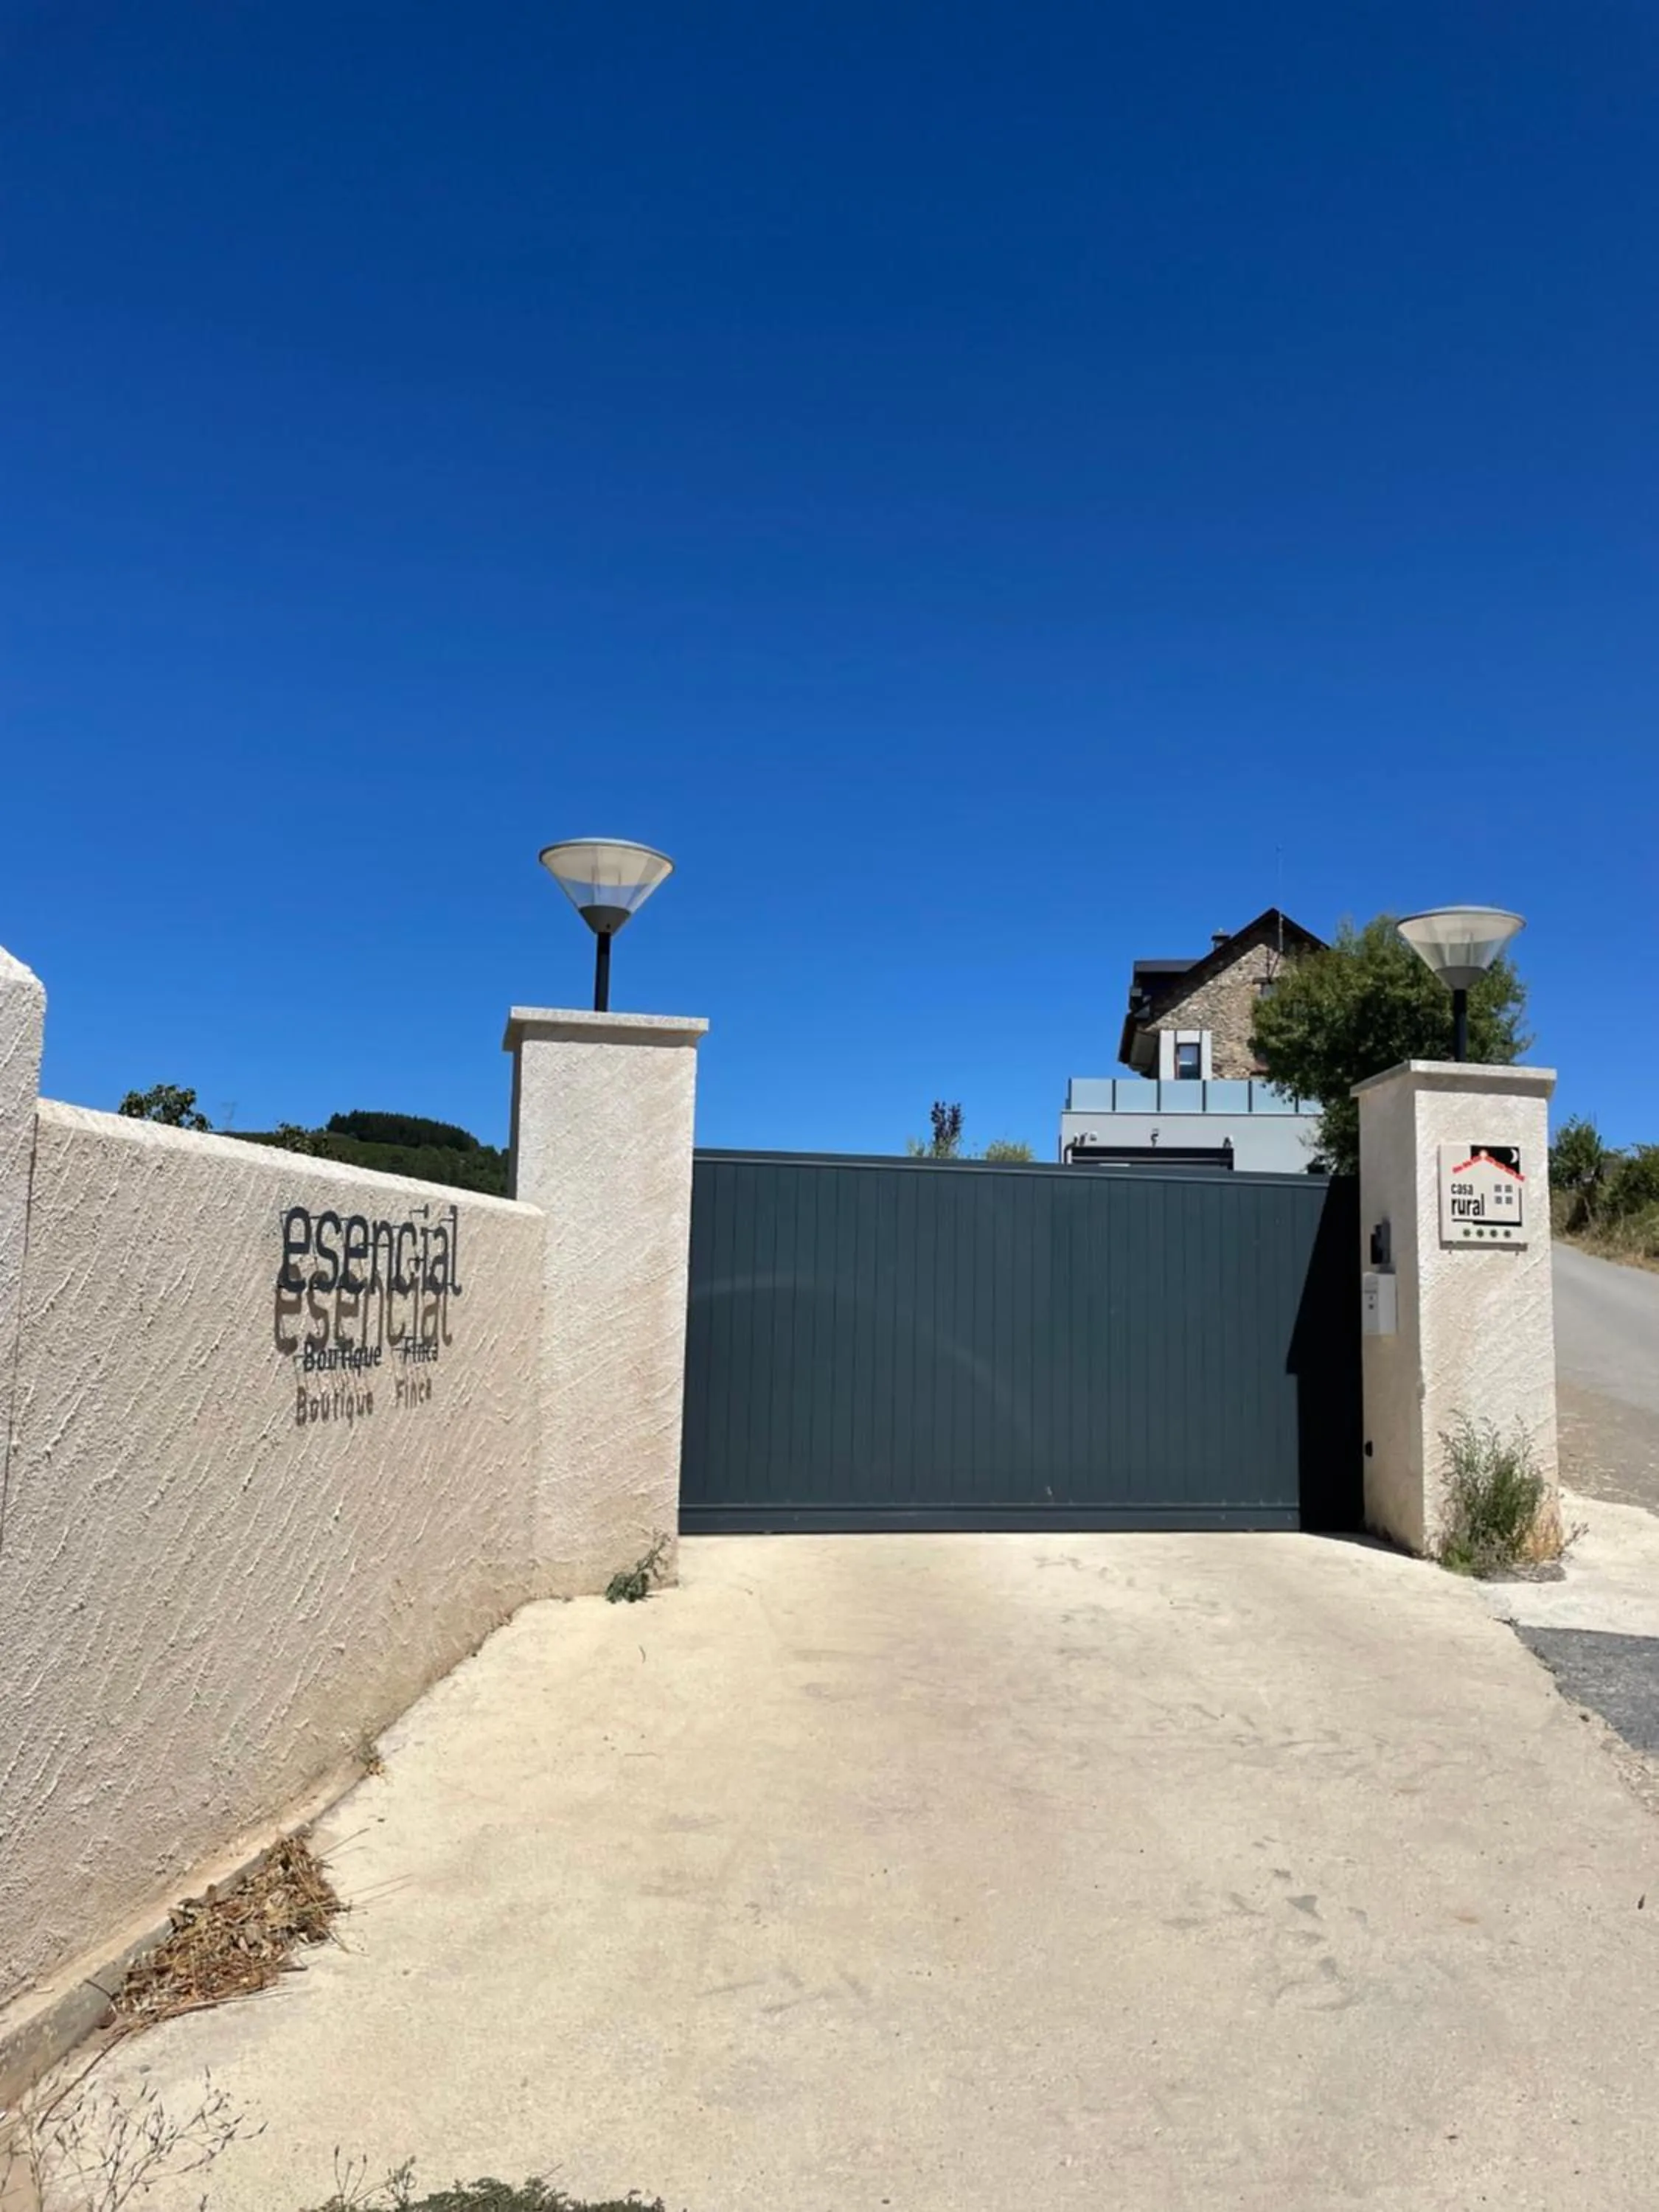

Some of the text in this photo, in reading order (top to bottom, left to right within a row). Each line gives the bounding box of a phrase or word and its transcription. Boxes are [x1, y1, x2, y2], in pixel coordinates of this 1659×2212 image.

[1450, 1183, 1473, 1195] casa
[1451, 1193, 1485, 1216] rural
[282, 1204, 462, 1296] esencial
[302, 1340, 382, 1376] Boutique
